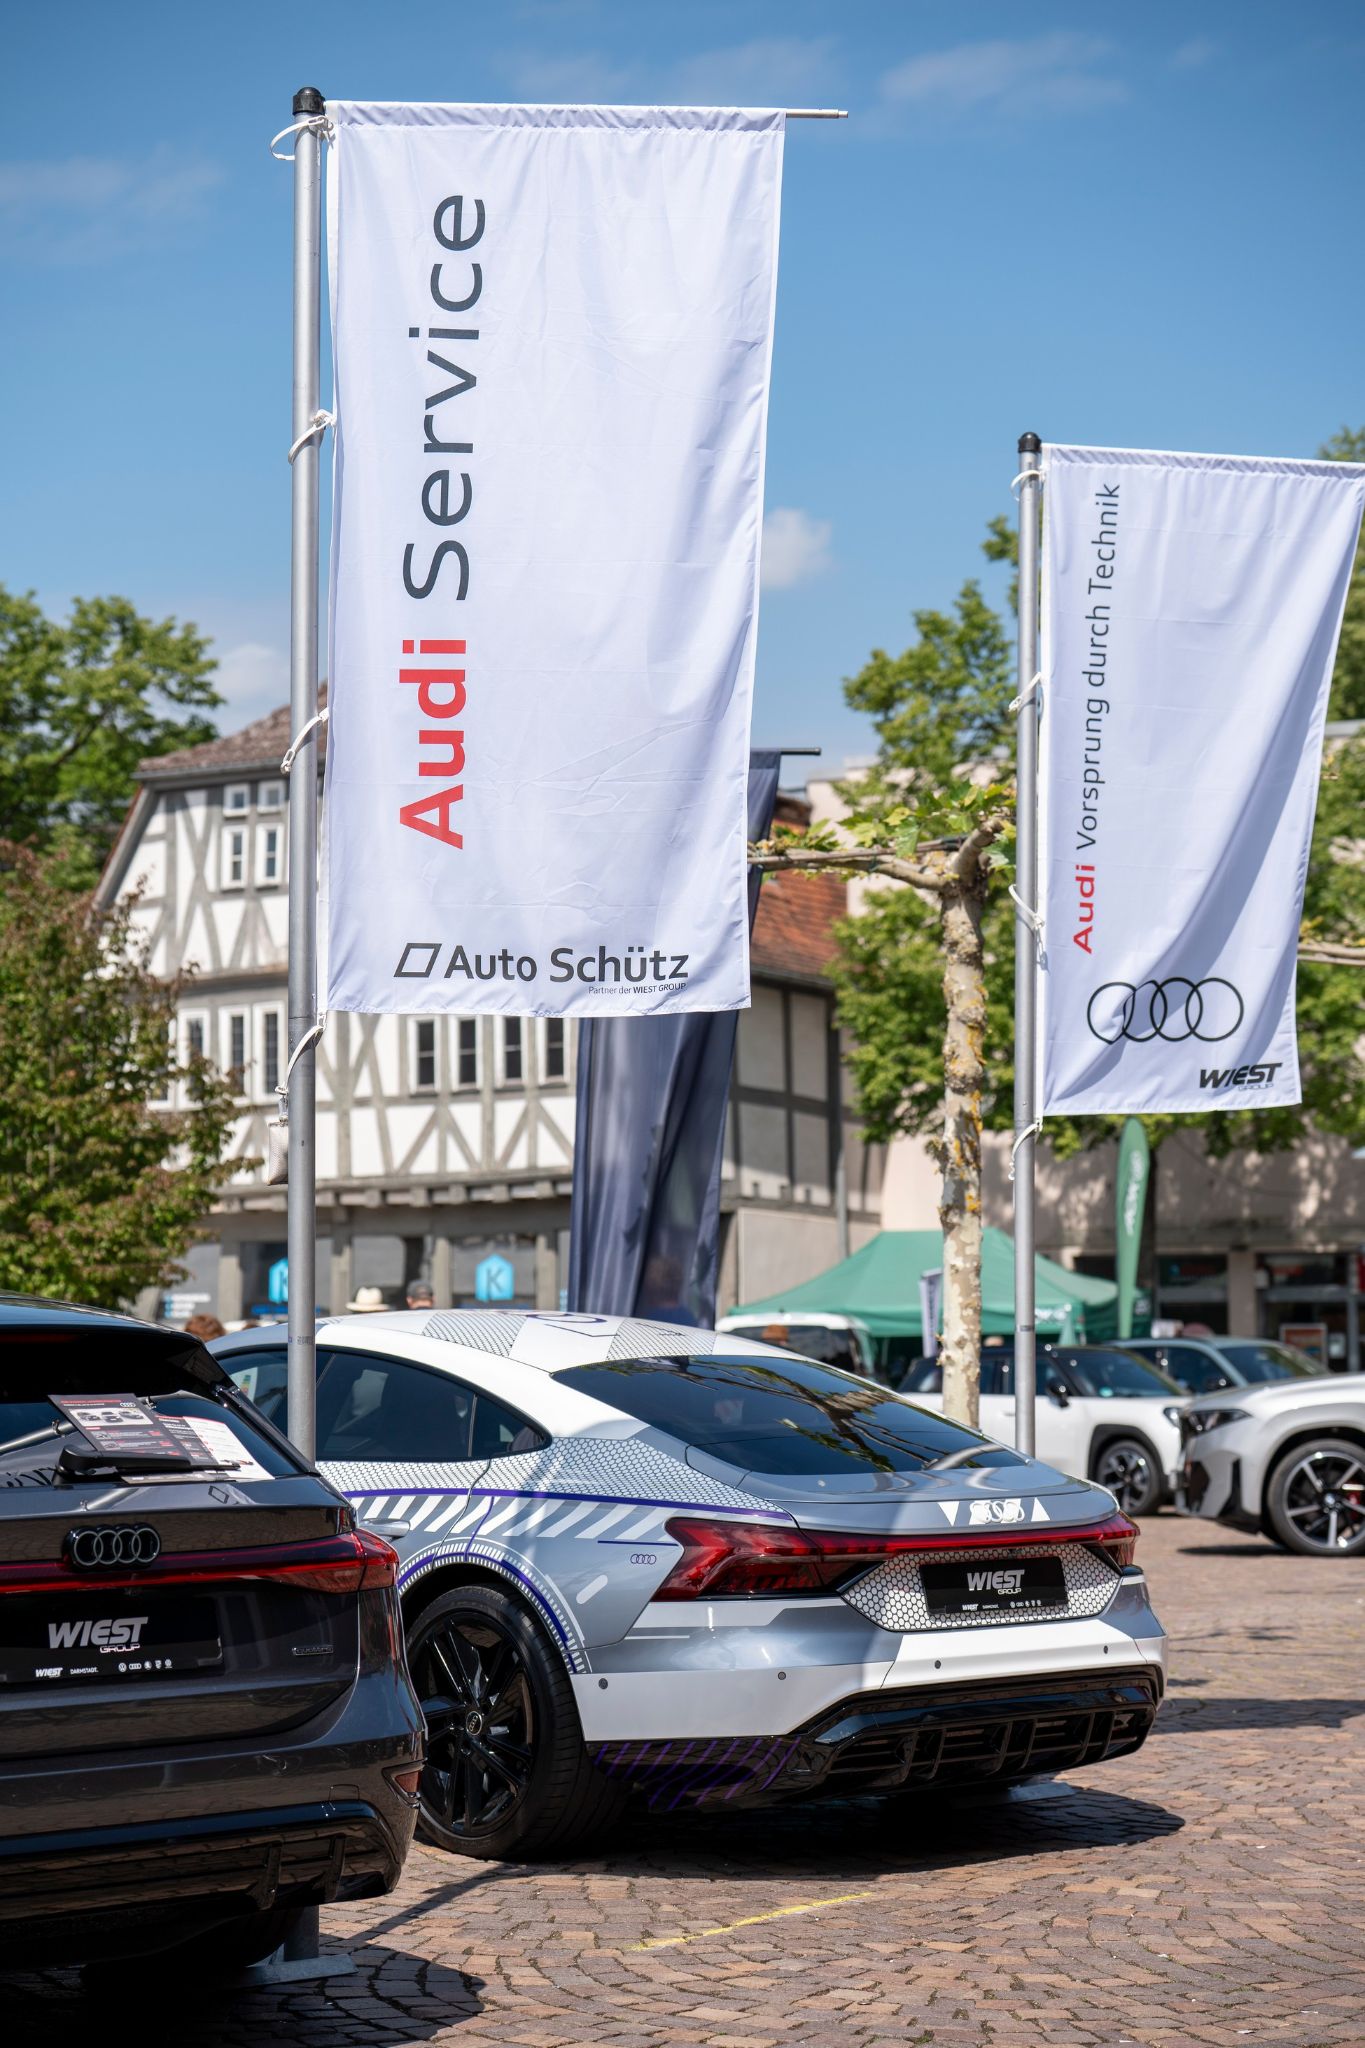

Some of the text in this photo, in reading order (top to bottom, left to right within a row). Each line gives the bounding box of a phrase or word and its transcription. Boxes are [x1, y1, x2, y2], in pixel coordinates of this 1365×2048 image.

[400, 195, 486, 850] Audi Service
[1073, 484, 1120, 954] Audi Vorsprung durch Technik
[443, 945, 690, 983] Auto Schütz
[588, 982, 687, 995] Partner der WIEST GROUP
[1199, 1062, 1283, 1088] WIEST
[967, 1569, 1025, 1592] WIEST
[997, 1587, 1022, 1595] GROUP
[48, 1616, 149, 1649] WIEST
[100, 1642, 141, 1654] GROUP
[35, 1667, 63, 1678] WIEST
